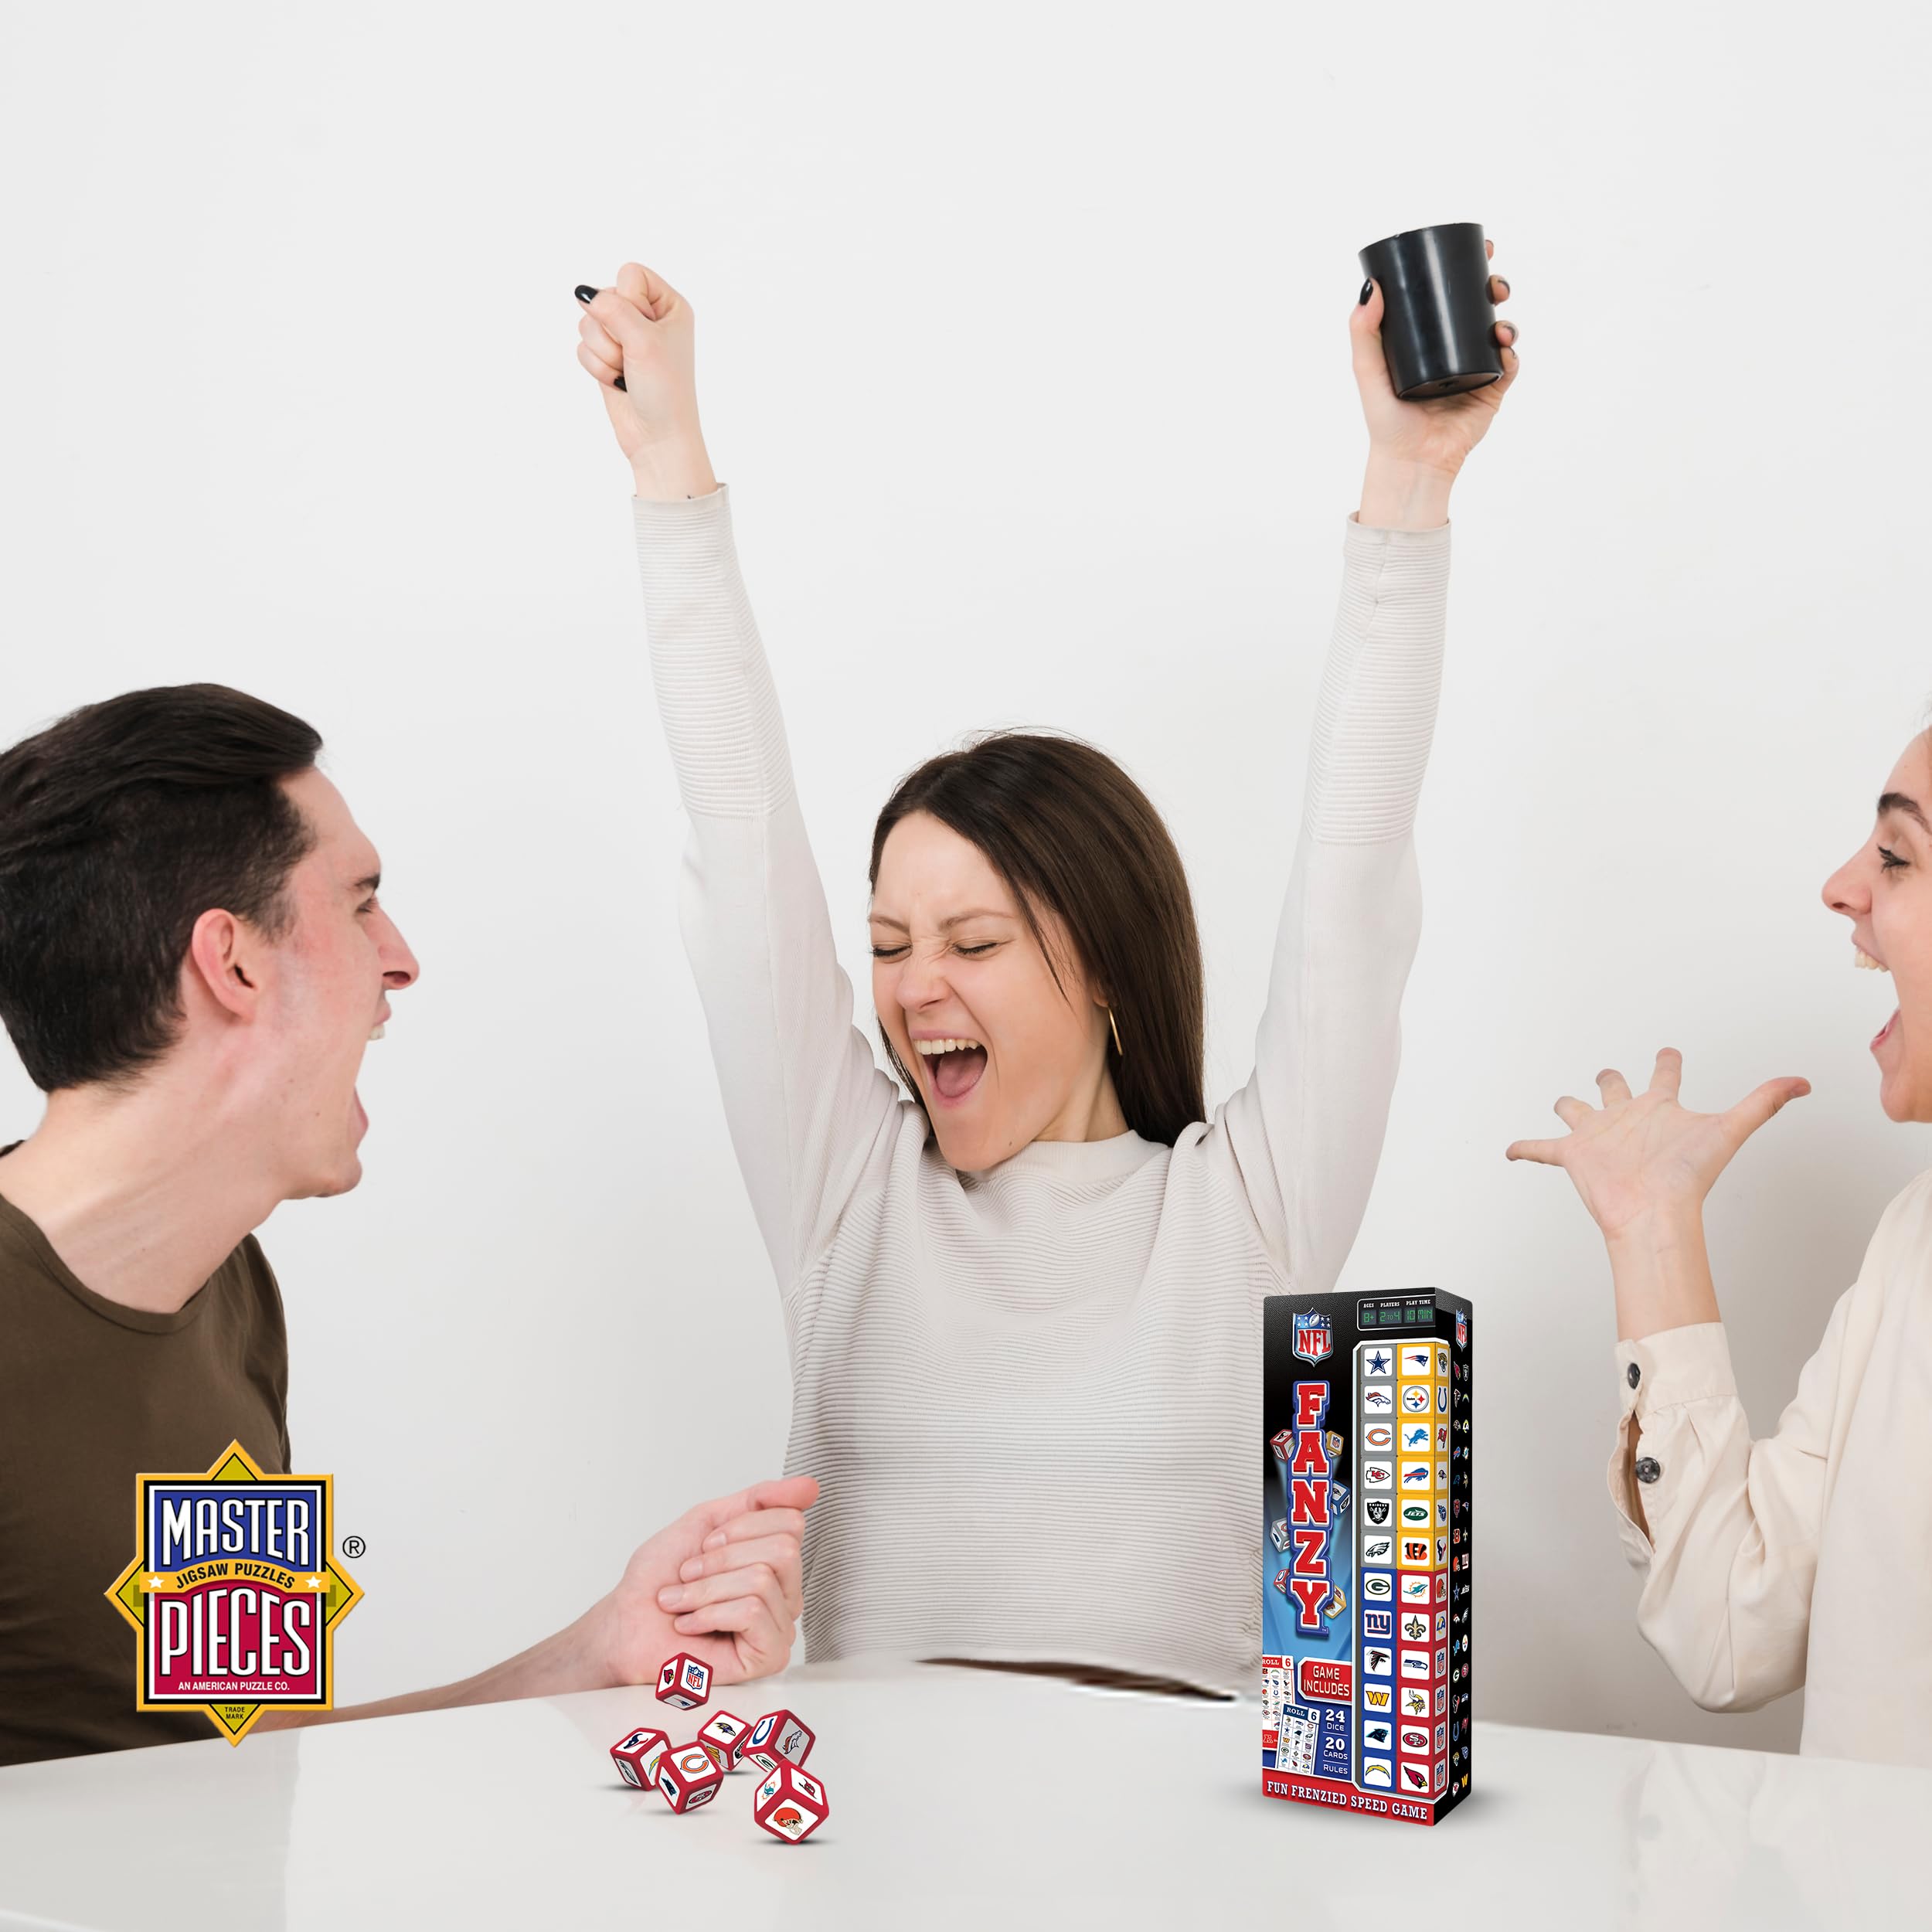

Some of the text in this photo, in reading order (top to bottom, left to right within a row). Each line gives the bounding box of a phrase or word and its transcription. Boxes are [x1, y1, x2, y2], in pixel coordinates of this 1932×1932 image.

[1363, 1312, 1374, 1323] 8+
[1406, 1309, 1433, 1321] 10 MIN
[1298, 1329, 1332, 1356] NFL
[1290, 1382, 1331, 1629] FANZY
[1285, 1658, 1291, 1667] 6
[1313, 1665, 1340, 1680] GAME
[687, 1673, 701, 1687] NFL
[1304, 1679, 1350, 1696] INCLUDES
[1286, 1706, 1305, 1717] ROLL
[1311, 1711, 1317, 1721] 6
[1325, 1709, 1345, 1723] 24
[1326, 1723, 1345, 1731] DICE
[1325, 1736, 1345, 1750] 20
[1323, 1750, 1349, 1760] CARDS
[1323, 1764, 1349, 1774] RULES
[1267, 1781, 1427, 1820] FUN FRENZIED SPEED GAME
